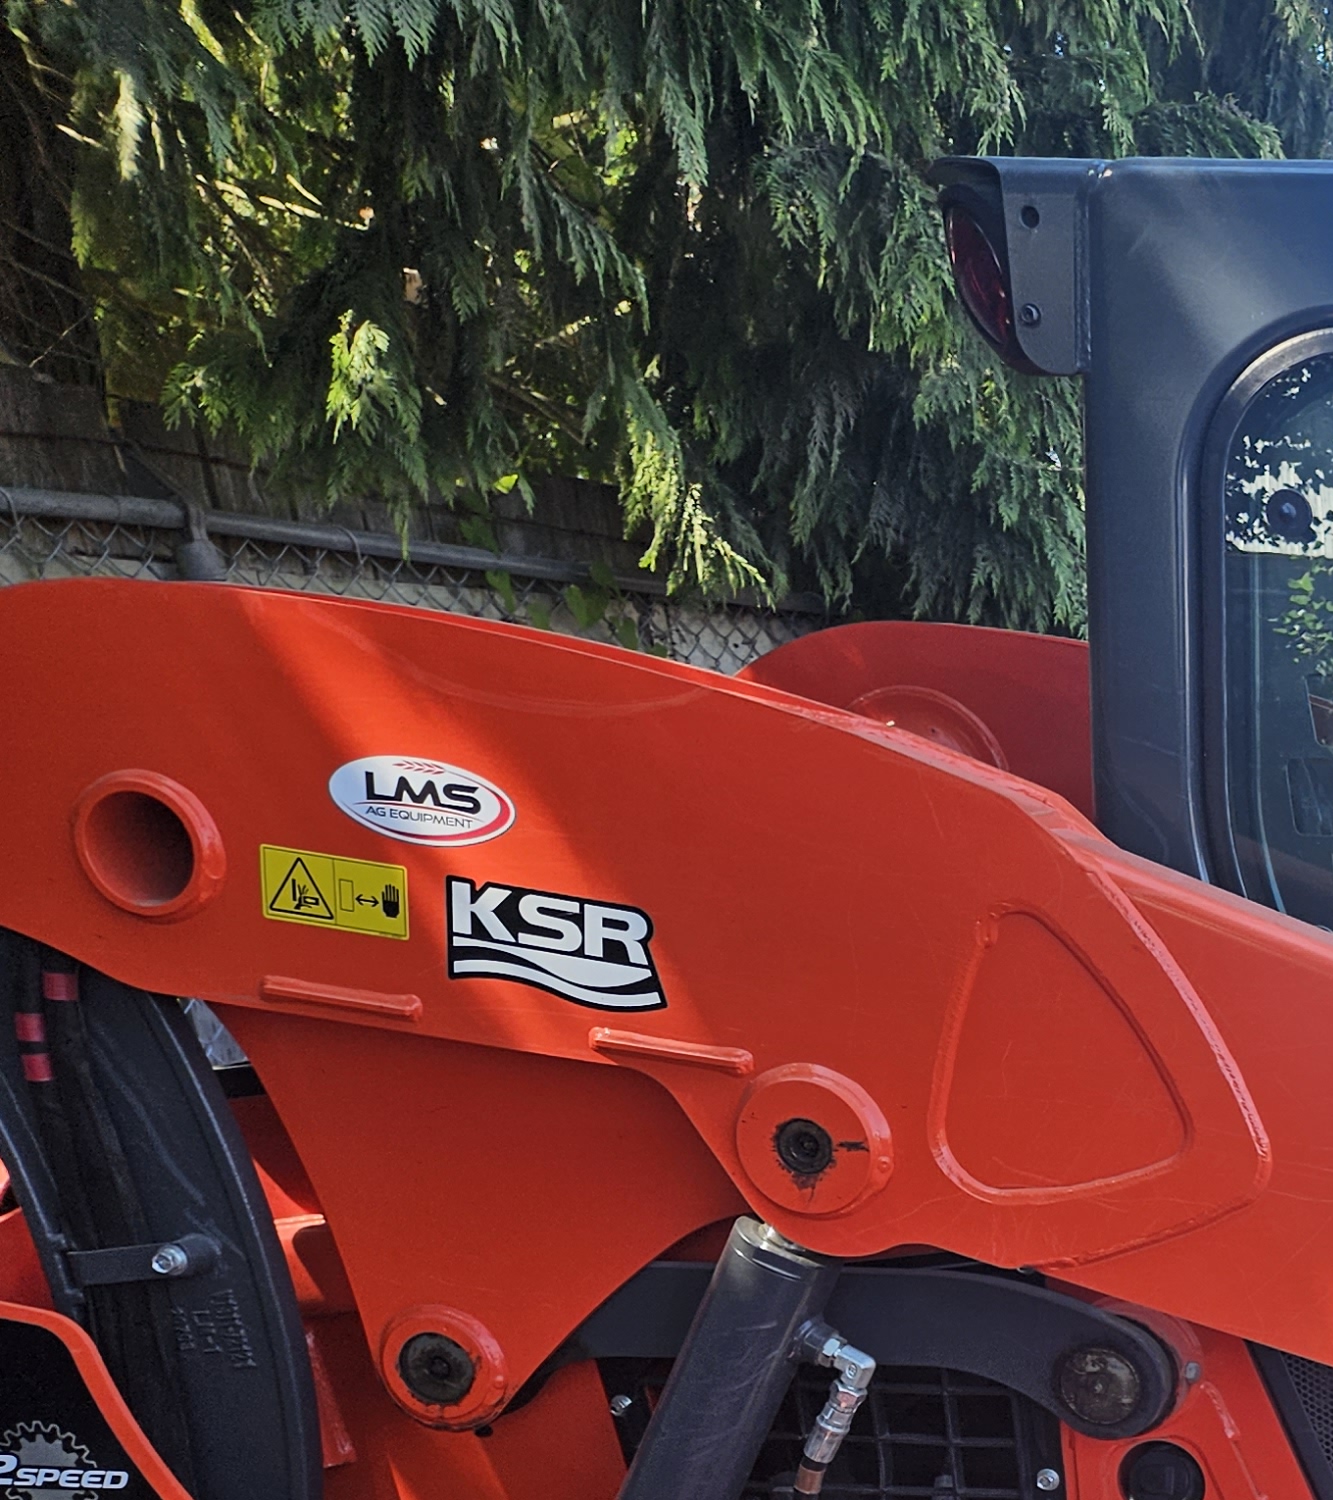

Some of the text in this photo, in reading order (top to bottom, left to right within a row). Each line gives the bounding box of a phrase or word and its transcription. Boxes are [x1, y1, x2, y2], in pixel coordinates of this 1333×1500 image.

[364, 770, 482, 815] LMS
[365, 805, 473, 829] AG EQUIPMENT
[451, 880, 649, 966] KSR
